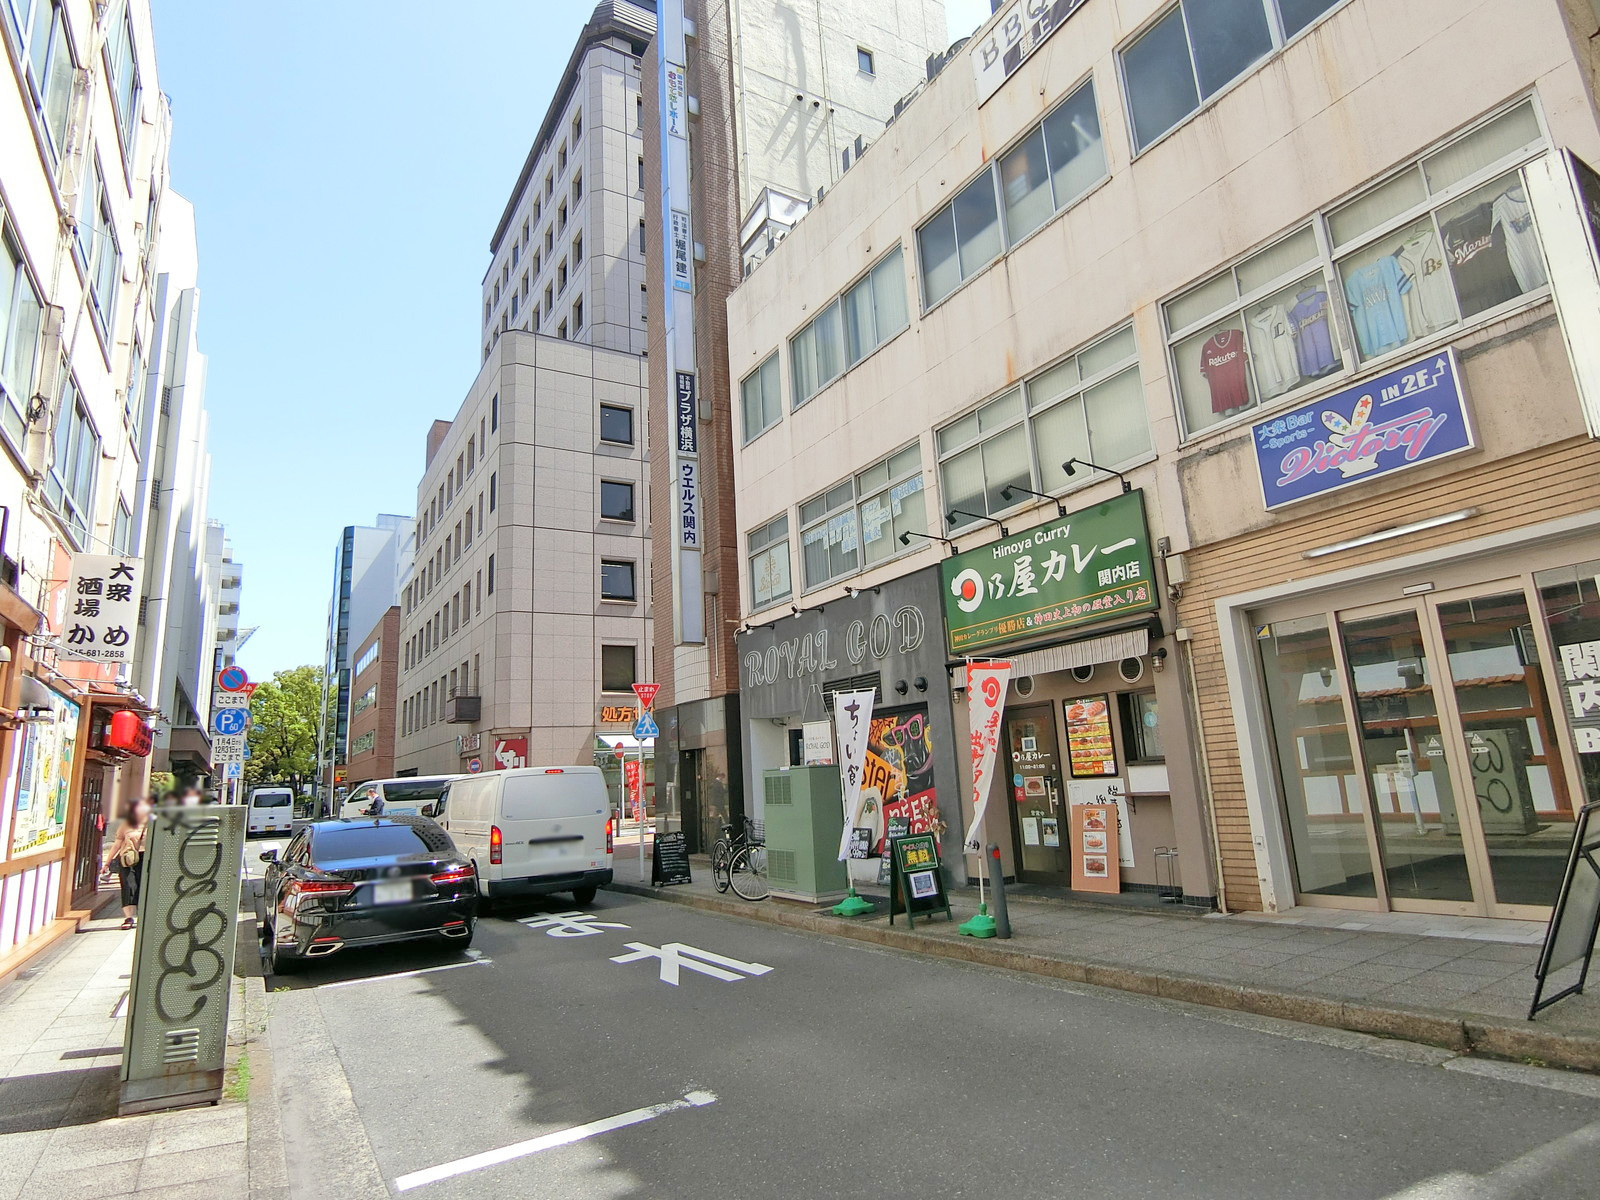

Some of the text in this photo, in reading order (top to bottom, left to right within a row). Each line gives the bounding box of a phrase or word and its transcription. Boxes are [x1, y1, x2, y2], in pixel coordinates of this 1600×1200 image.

[675, 239, 688, 279] 堀尾建一
[1424, 258, 1443, 276] Bs
[1208, 351, 1237, 366] Rakute
[1380, 369, 1430, 402] IN 2F
[679, 390, 694, 451] プラザ横浜
[1276, 407, 1447, 487] Victory
[682, 464, 696, 544] ウエルス関内
[992, 524, 1071, 560] Hinoya Curry
[106, 562, 134, 602] 大衆
[1097, 560, 1141, 587] 関内店
[74, 576, 104, 618] 酒場
[67, 624, 130, 647] かめ
[744, 604, 925, 688] ROYAL GOD
[218, 696, 245, 704] ここまで
[221, 715, 234, 731] P
